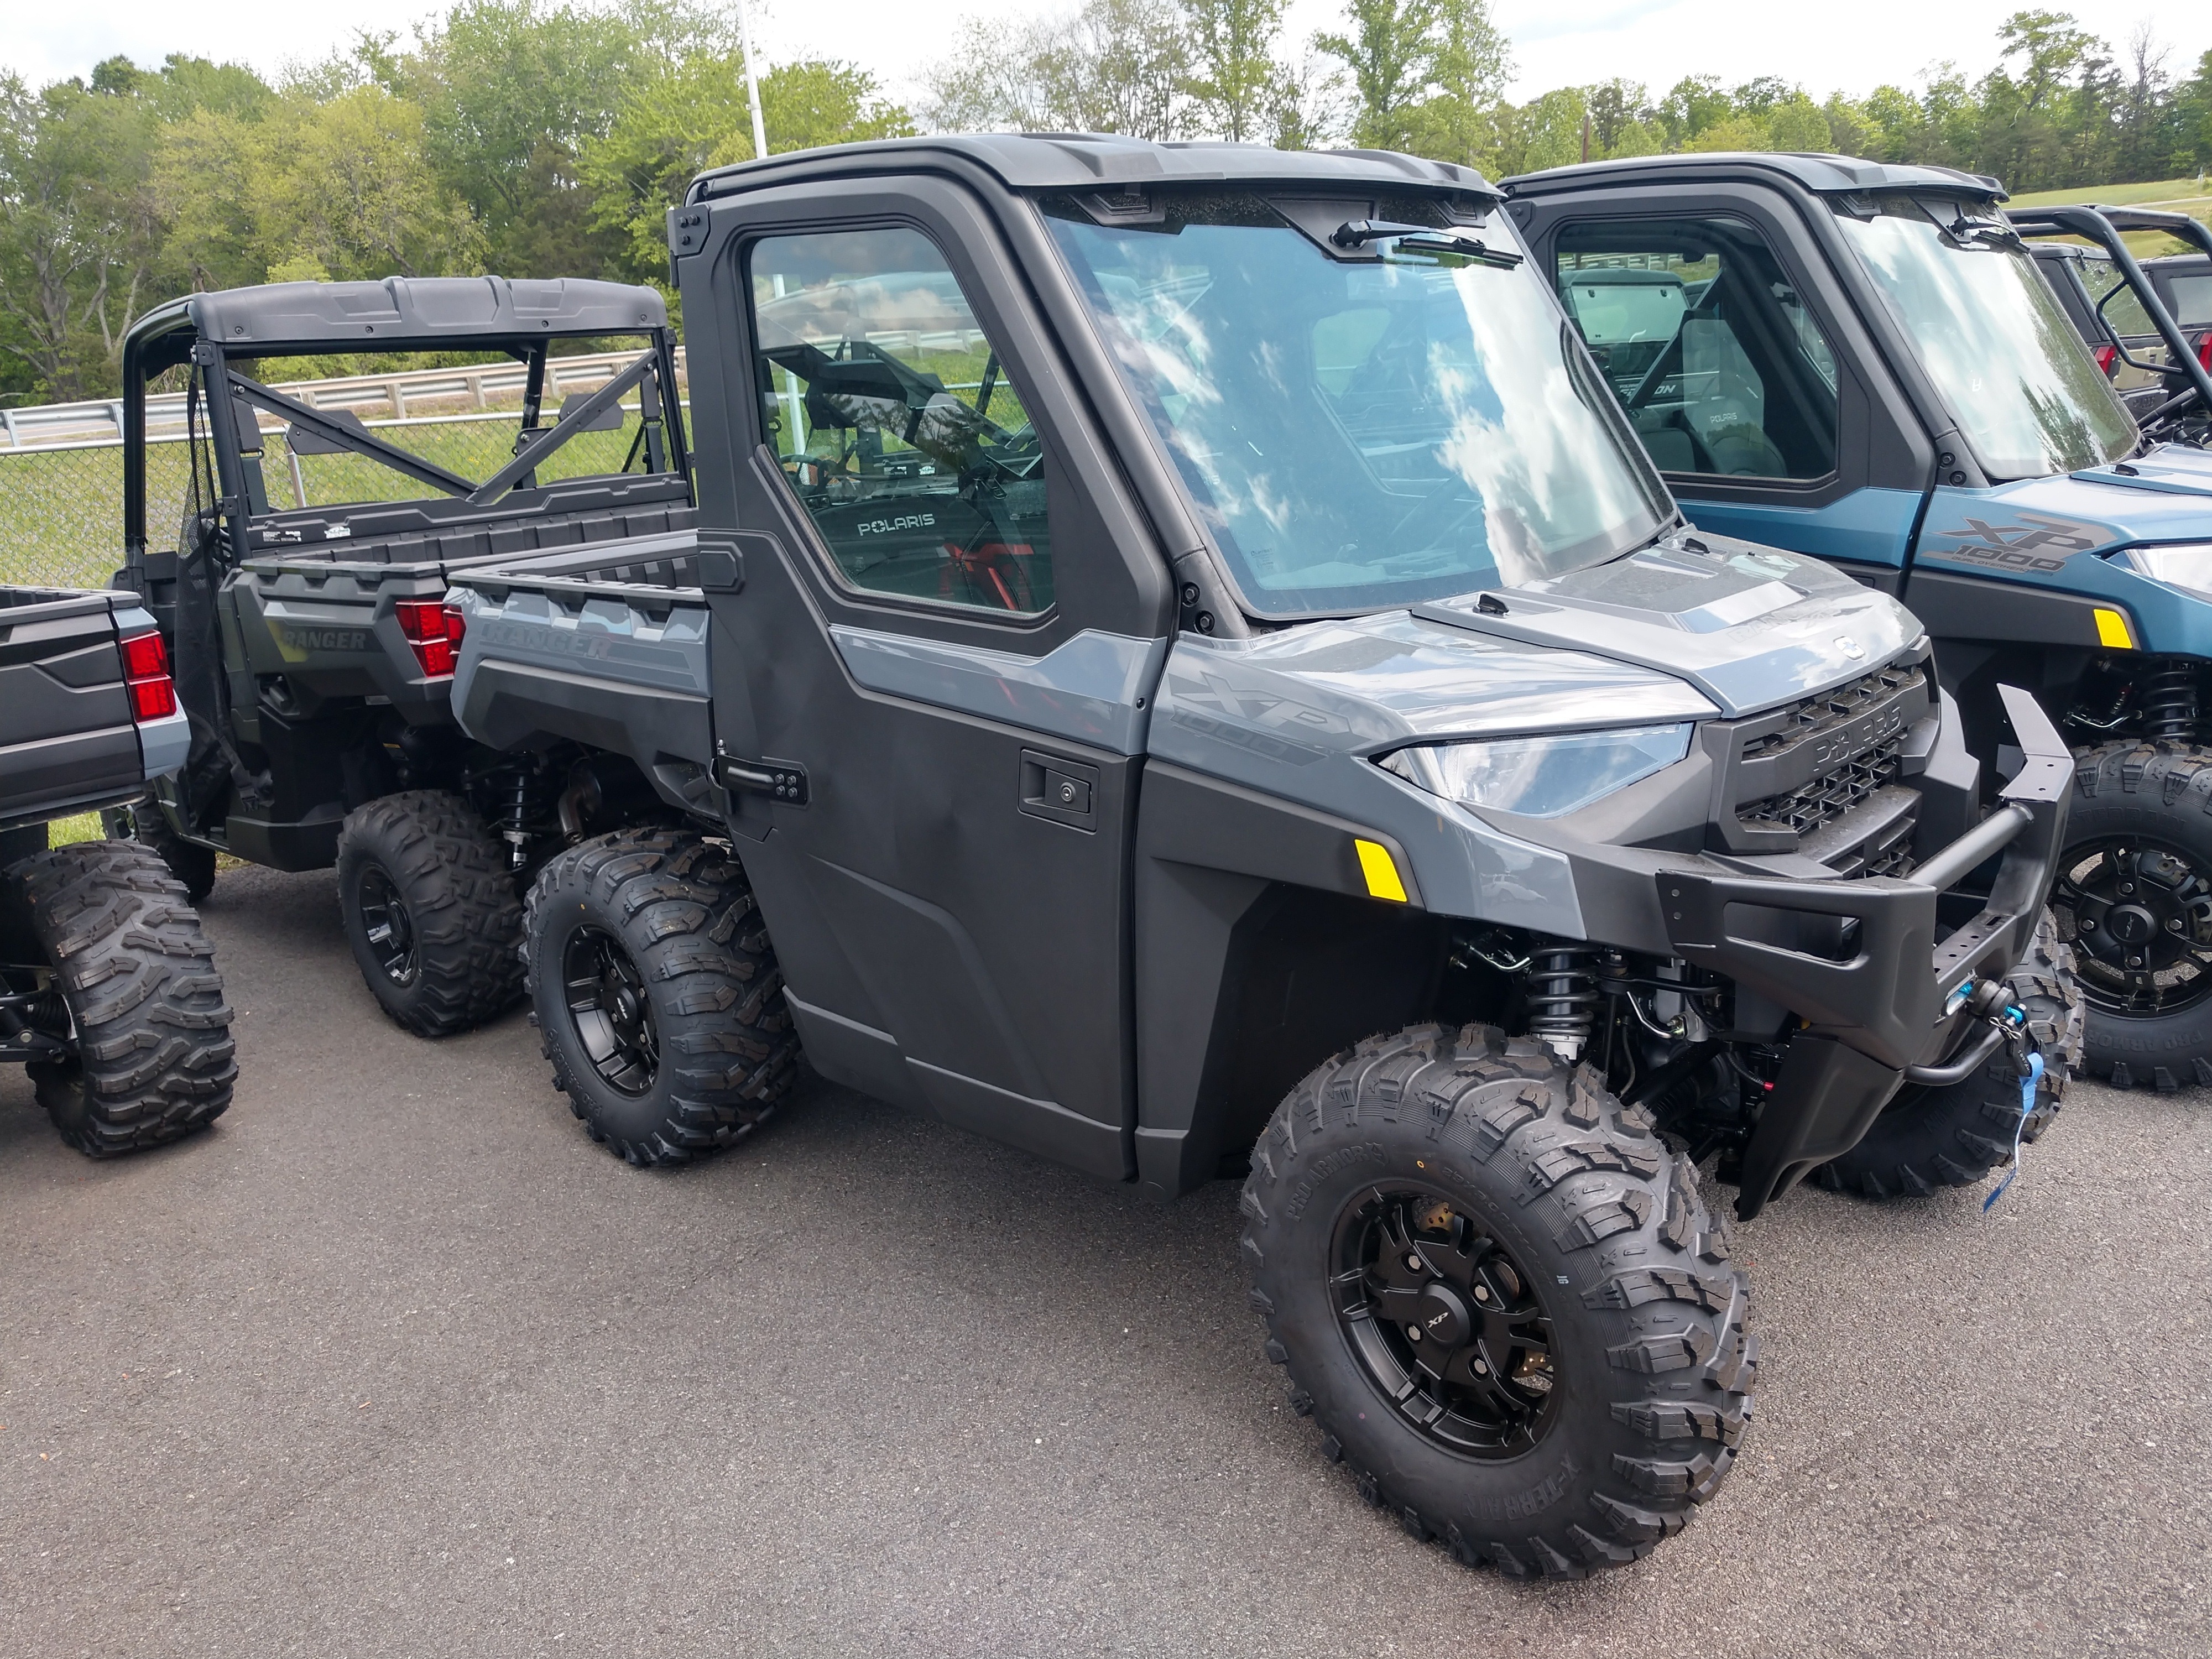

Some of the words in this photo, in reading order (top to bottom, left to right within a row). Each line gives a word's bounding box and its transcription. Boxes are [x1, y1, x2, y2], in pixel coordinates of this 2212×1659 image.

[857, 513, 935, 536] POLARIS
[1932, 517, 2096, 550] XP
[1955, 544, 2066, 571] 1000
[283, 631, 366, 650] RANGER
[487, 621, 612, 659] RANGER
[1171, 670, 1353, 734] XP
[1813, 705, 1901, 771] POLARIS
[1287, 1182, 1312, 1223] PRO
[1308, 1145, 1370, 1187] ARMOR
[1428, 1312, 1448, 1328] XP
